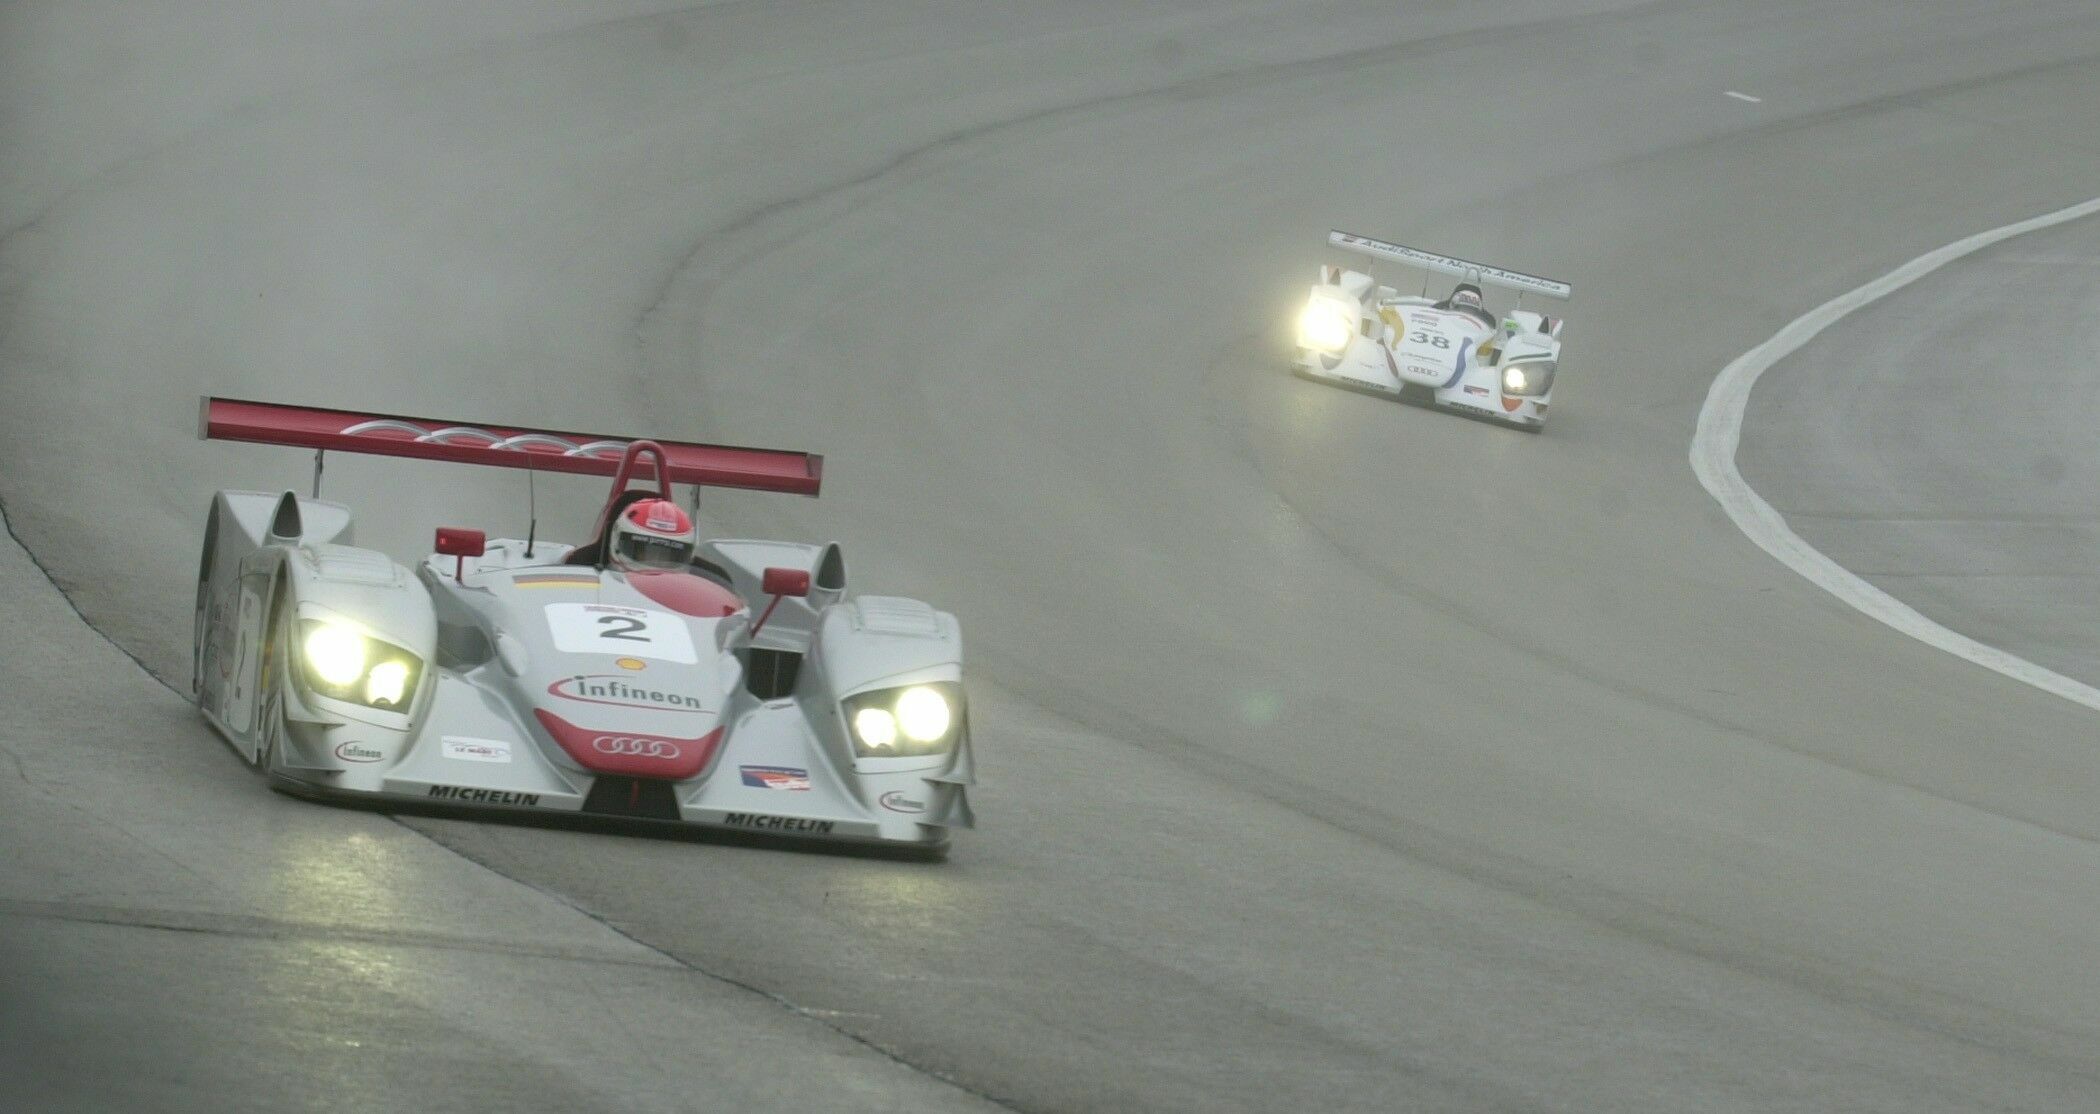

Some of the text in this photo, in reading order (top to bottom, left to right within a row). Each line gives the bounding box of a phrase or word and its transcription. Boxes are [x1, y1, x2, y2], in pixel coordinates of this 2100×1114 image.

[1410, 331, 1449, 349] 38
[598, 616, 651, 642] 2
[429, 785, 541, 806] MICHELIN
[725, 812, 834, 833] MICHELIN
